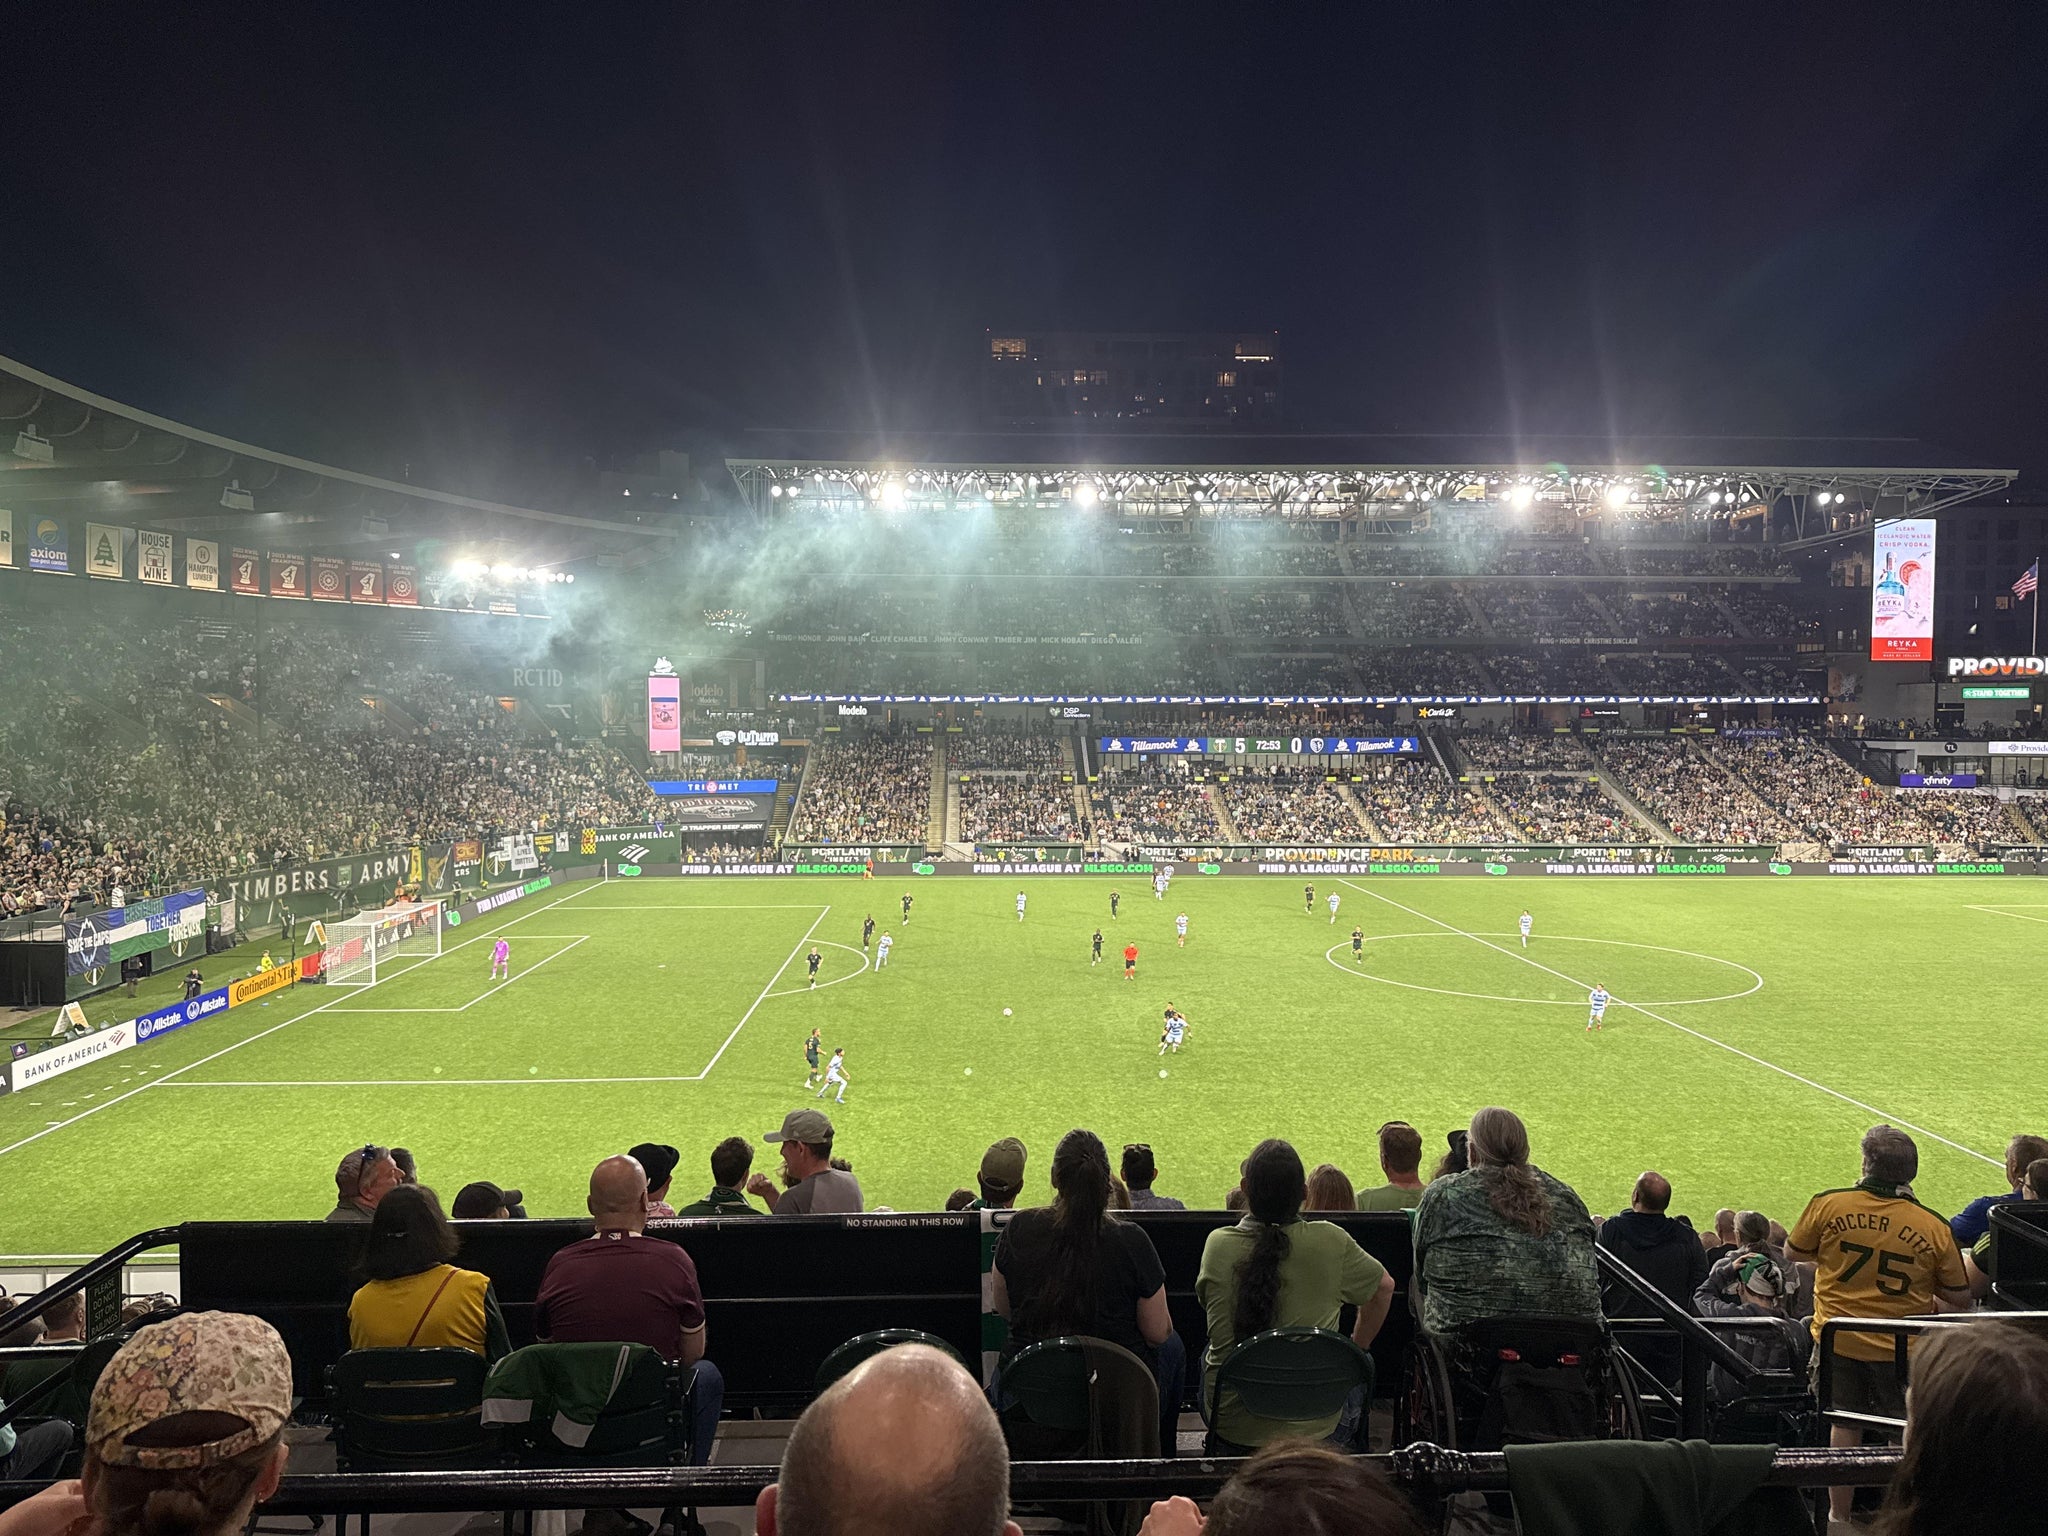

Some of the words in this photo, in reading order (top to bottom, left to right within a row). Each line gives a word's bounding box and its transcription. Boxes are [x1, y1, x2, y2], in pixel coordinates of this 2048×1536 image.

[141, 532, 170, 548] HOUSE
[30, 547, 67, 560] axiom
[143, 566, 167, 580] WINE
[188, 562, 217, 574] HAMPTON
[193, 572, 213, 581] LUMBER
[798, 634, 821, 642] HONOR
[1949, 657, 2048, 675] PROVID
[513, 668, 563, 687] RCTID
[1972, 689, 1994, 697] STAND
[839, 705, 867, 715] Modelo
[1131, 738, 1178, 752] Tillamook
[1235, 738, 1246, 753] 5
[1255, 740, 1280, 750] 72:53
[1291, 737, 1302, 753] 0
[1356, 738, 1394, 752] Tillamook
[1922, 775, 1953, 786] xfinity
[669, 799, 692, 808] OLD
[693, 797, 758, 808] TRAPPER
[595, 834, 618, 842] BANK
[619, 832, 631, 840] OF
[633, 830, 675, 840] AMERICA
[812, 847, 871, 856] PORTLAND
[1370, 848, 1415, 860] PARK
[359, 853, 411, 884] ARMY
[455, 868, 470, 877] ERS
[682, 864, 710, 874] FIND
[712, 864, 723, 874] A
[725, 864, 773, 874] LEAGUE
[776, 864, 793, 874] AT
[796, 864, 866, 874] MLSGO.COM
[974, 864, 1000, 873] FIND
[1003, 864, 1014, 873] A
[1015, 864, 1062, 873] LEAGUE
[1064, 864, 1081, 873] AT
[1084, 864, 1153, 873] MLSGO.COM
[1259, 864, 1286, 873] FIND
[1289, 864, 1298, 873] A
[1300, 864, 1347, 873] LEAGUE
[1350, 864, 1367, 873] AT
[1369, 864, 1439, 873] MLSGO.COM
[1547, 864, 1573, 873] FIND
[1576, 864, 1587, 873] A
[1588, 864, 1635, 873] LEAGUE
[1637, 864, 1654, 873] AT
[1657, 864, 1726, 873] MLSGO.COM
[1829, 864, 1856, 873] FIND
[1858, 864, 1869, 873] A
[1870, 864, 1915, 873] LEAGUE
[1918, 864, 1934, 873] AT
[1937, 864, 2004, 873] MLSGO.COM
[229, 869, 328, 900] TIMBERS
[145, 911, 181, 932] TOGETHER
[168, 922, 201, 943] FOREVER
[67, 937, 84, 954] SAVE
[84, 936, 93, 948] THE
[94, 930, 110, 947] CAPS
[236, 975, 276, 1002] Continental
[283, 965, 297, 981] Tire
[199, 995, 227, 1014] Allstate
[152, 1012, 182, 1033] Allstate
[25, 1061, 51, 1079] BANK
[54, 1056, 66, 1068] OF
[67, 1041, 108, 1064] AMERICA
[647, 1219, 693, 1229] SECTION
[846, 1218, 860, 1227] NO
[862, 1218, 907, 1227] STANDING
[909, 1218, 918, 1226] IN
[920, 1218, 940, 1226] THIS
[942, 1218, 964, 1226] ROW
[1828, 1213, 1890, 1235] SOCCER
[1898, 1225, 1936, 1255] CITY
[1836, 1240, 1915, 1296] 75
[94, 1277, 115, 1297] PLEASE
[93, 1297, 102, 1310] DO
[103, 1288, 117, 1304] NOT
[94, 1308, 104, 1321] SIT
[104, 1302, 115, 1315] ON
[91, 1311, 118, 1337] RAILINGS
